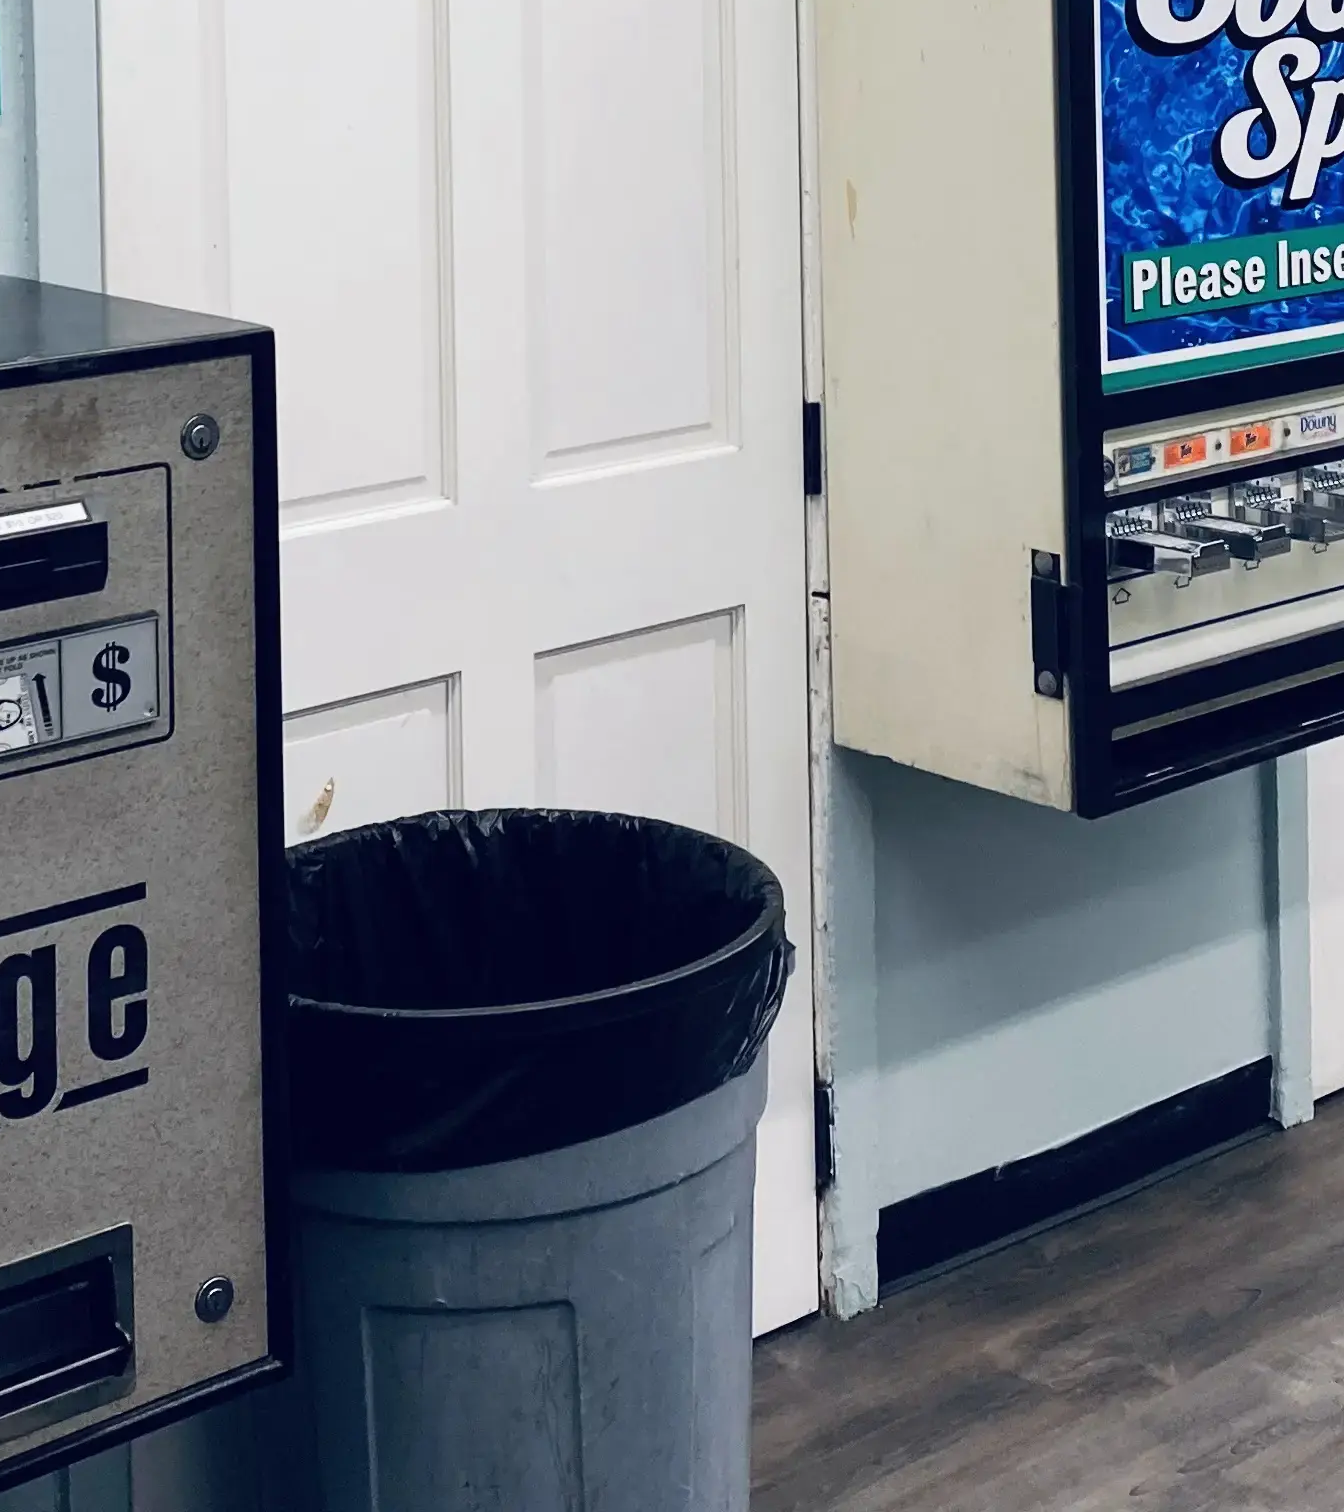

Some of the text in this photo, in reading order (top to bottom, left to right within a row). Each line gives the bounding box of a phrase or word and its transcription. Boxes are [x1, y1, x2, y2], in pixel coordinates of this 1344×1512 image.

[1132, 258, 1265, 311] Please
[1300, 413, 1336, 433] Downy
[4, 662, 23, 672] FOLD
[6, 655, 16, 664] UP
[91, 641, 131, 713] $
